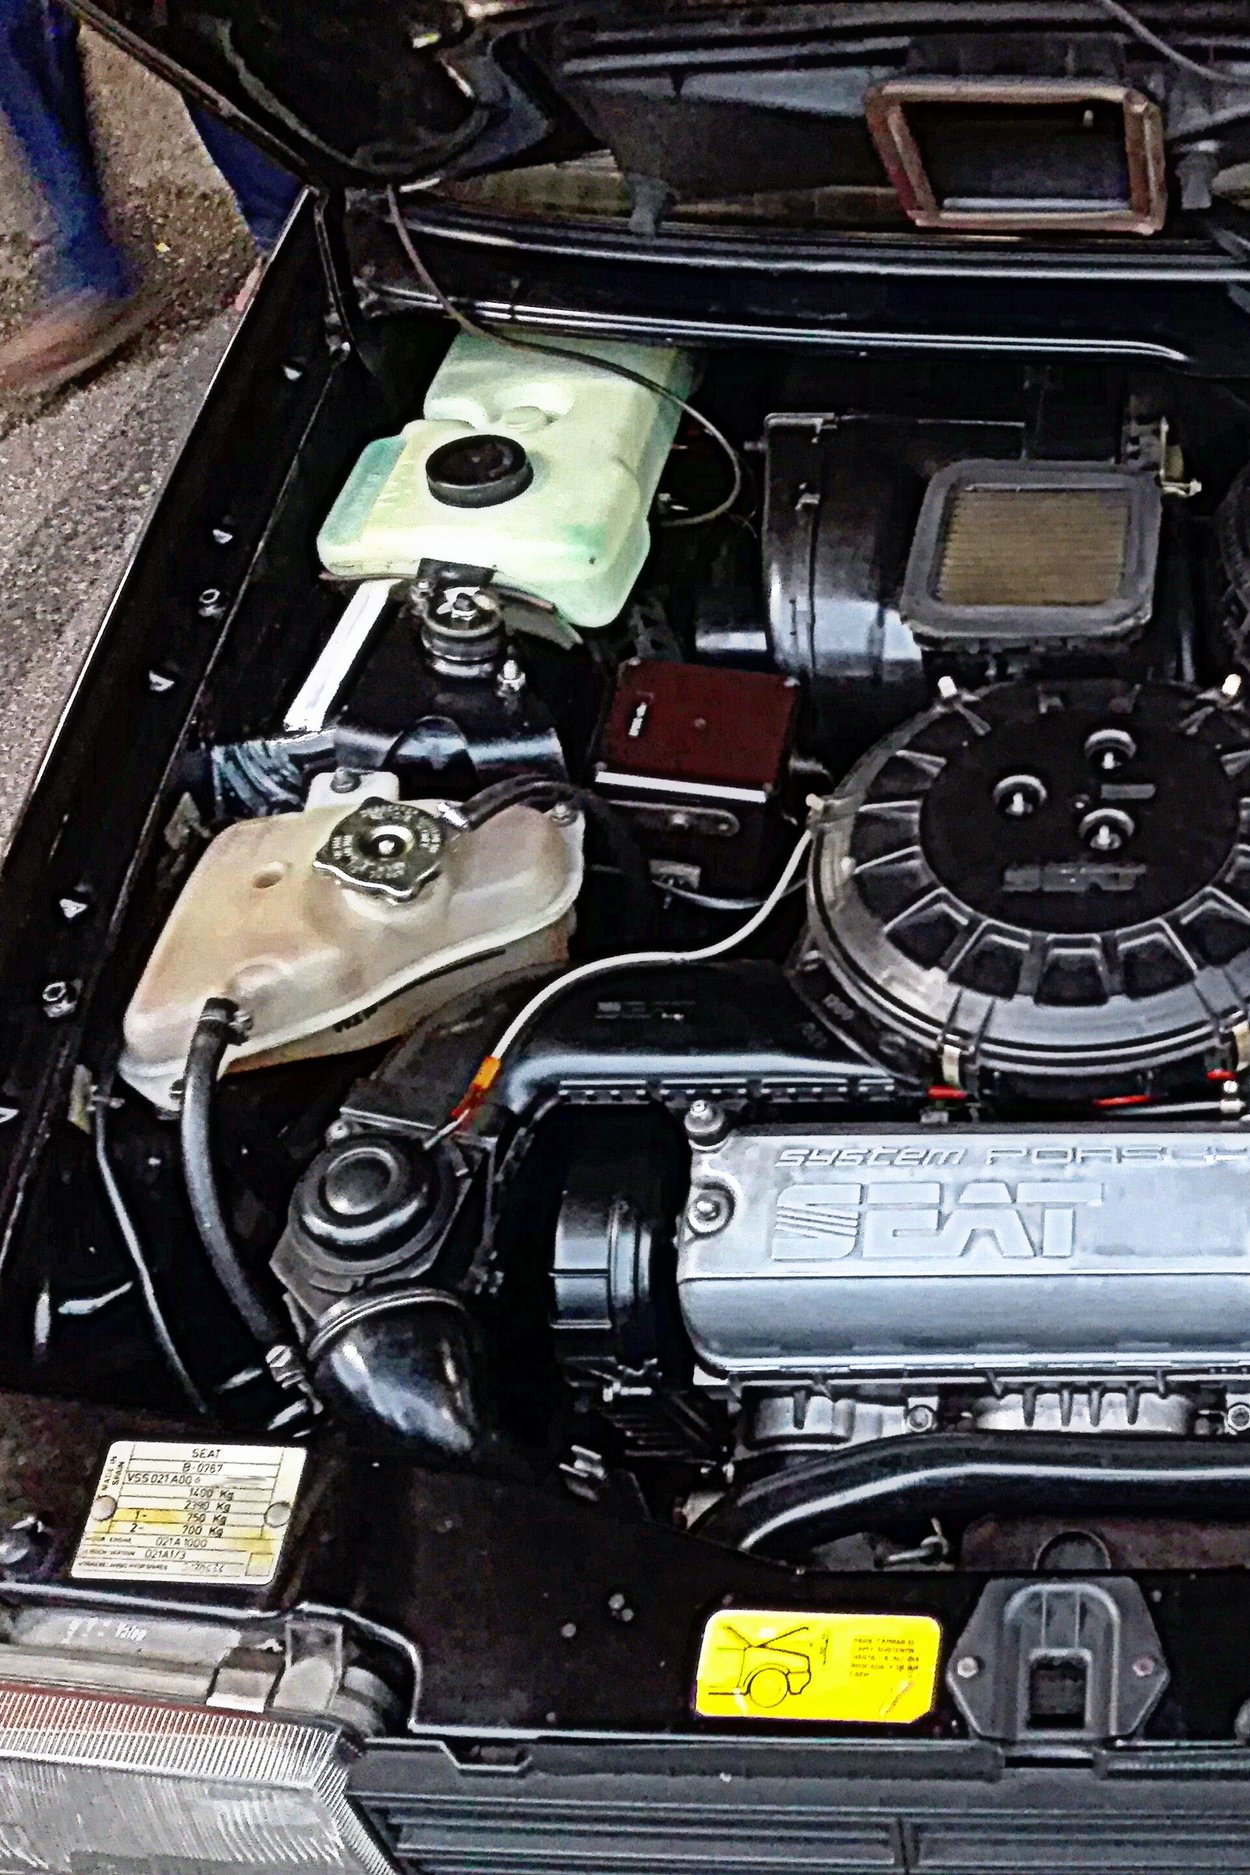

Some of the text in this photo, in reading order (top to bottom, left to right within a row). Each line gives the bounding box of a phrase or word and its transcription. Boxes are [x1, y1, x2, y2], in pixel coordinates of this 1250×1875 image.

[774, 1146, 969, 1168] system
[771, 1182, 1104, 1260] SEAT
[192, 1448, 221, 1458] SEAT
[128, 1473, 200, 1485] VSS021A00
[189, 1487, 213, 1497] 1400
[187, 1513, 206, 1522] 750
[182, 1525, 203, 1535] 700
